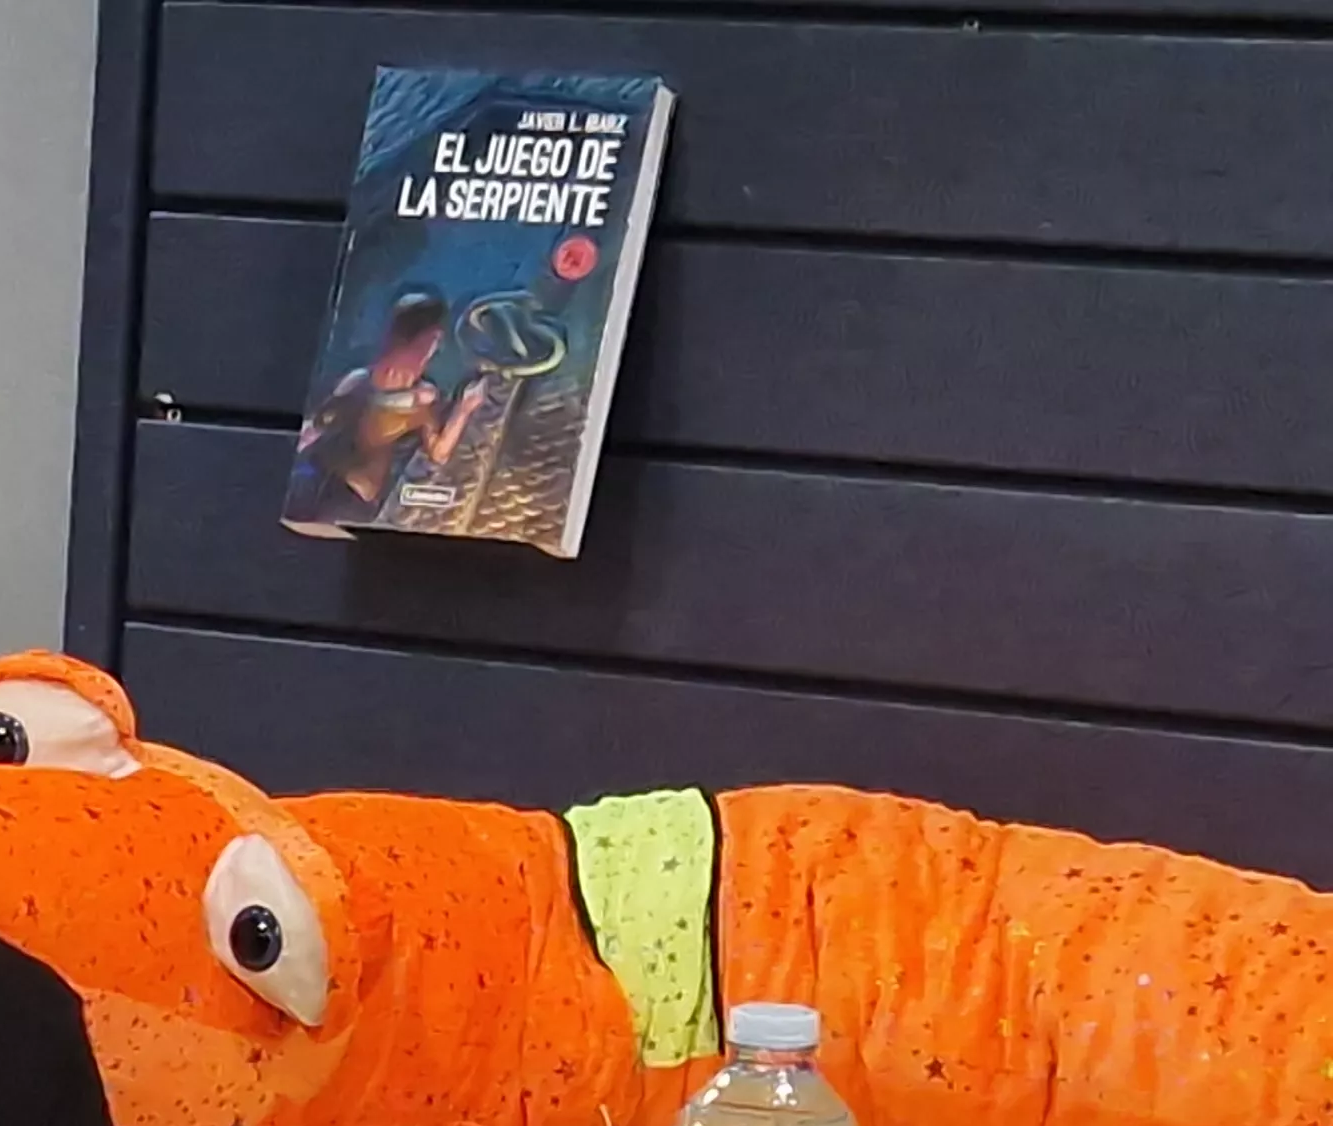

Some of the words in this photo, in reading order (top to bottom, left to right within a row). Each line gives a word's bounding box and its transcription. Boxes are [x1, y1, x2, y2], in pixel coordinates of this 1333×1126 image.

[517, 111, 565, 131] JAVIER
[434, 132, 471, 173] EL
[474, 133, 573, 178] JUEGO
[576, 138, 621, 180] DE
[397, 175, 437, 217] LA
[445, 178, 611, 227] SERPIENTE
